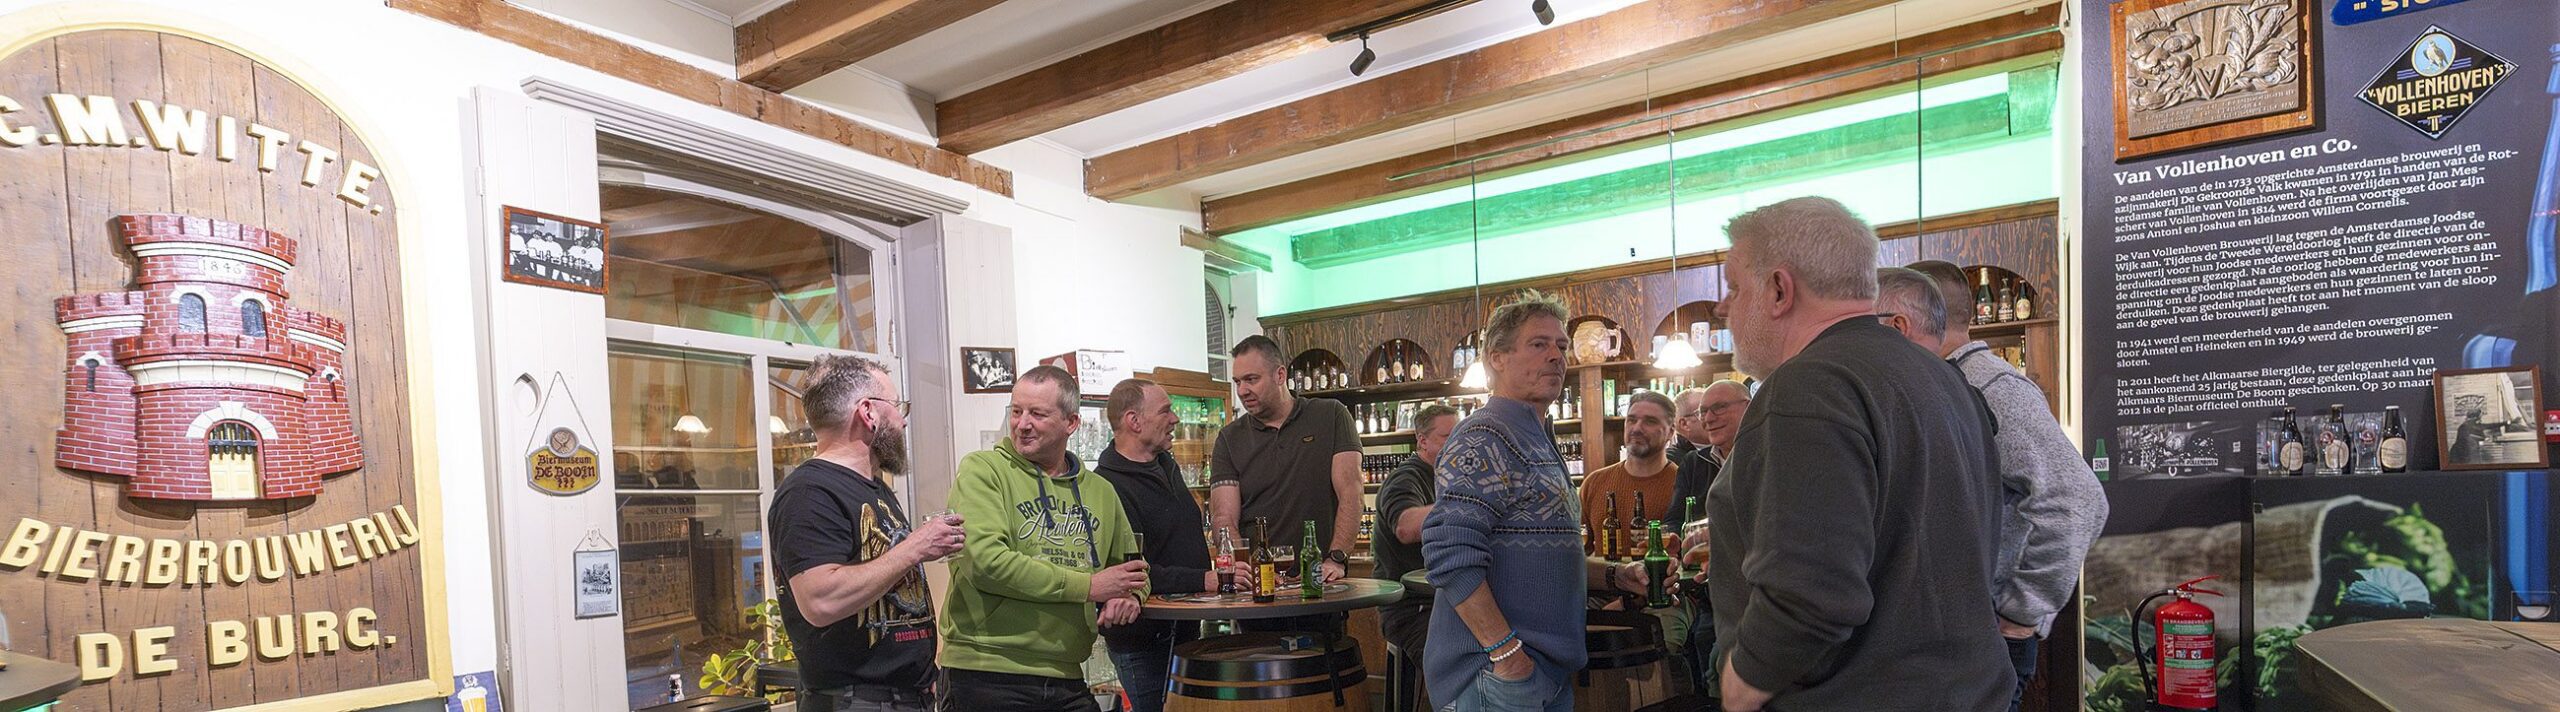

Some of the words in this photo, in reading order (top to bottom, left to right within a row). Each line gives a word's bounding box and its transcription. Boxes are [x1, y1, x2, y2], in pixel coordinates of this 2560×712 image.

[2397, 92, 2474, 117] BIEREN
[2112, 170, 2151, 186] Van
[2154, 149, 2286, 180] Vollenhoven
[2289, 144, 2318, 159] en
[2321, 137, 2357, 155] Co.
[2114, 194, 2128, 204] De
[2129, 188, 2176, 201] aandelen
[2177, 185, 2197, 195] van
[2199, 182, 2212, 191] de
[2214, 180, 2225, 189] in
[2227, 177, 2252, 189] 1733
[2253, 167, 2314, 185] opgerichte
[2315, 156, 2398, 175] Amsterdamse
[2400, 144, 2462, 163] brouwerij
[2464, 144, 2481, 153] en
[2114, 196, 2178, 213] azijnmakerij
[2180, 194, 2194, 204] De
[2196, 186, 2255, 202] Gekroonde
[2256, 181, 2282, 193] Valk
[2284, 176, 2333, 190] kwamen
[2335, 172, 2348, 182] in
[2350, 170, 2376, 182] 1791
[2378, 166, 2391, 176] in
[2393, 160, 2440, 174] handen
[2442, 157, 2466, 168] van
[2468, 153, 2485, 164] de
[2487, 148, 2518, 161] Rot-
[2114, 210, 2162, 223] terdamse
[2164, 203, 2201, 216] familie
[2202, 202, 2222, 211] van
[2224, 192, 2296, 208] Vollenhoven.
[2299, 188, 2315, 198] Na
[2317, 184, 2337, 195] het
[2338, 177, 2400, 192] overlijden
[2401, 174, 2425, 184] van
[2426, 170, 2448, 182] Jan
[2450, 166, 2485, 177] Mes-
[2114, 221, 2146, 233] schert
[2148, 220, 2167, 228] van
[2168, 210, 2235, 225] Vollenhoven
[2237, 207, 2248, 216] in
[2250, 205, 2275, 214] 1814
[2276, 199, 2306, 211] werd
[2308, 198, 2322, 207] de
[2324, 194, 2357, 205] firma
[2359, 183, 2425, 200] voortgezet
[2427, 181, 2458, 191] door
[2459, 176, 2484, 187] zijn
[2114, 233, 2144, 242] zoons
[2146, 226, 2182, 238] Antoni
[2199, 220, 2235, 233] Joshua
[2253, 211, 2309, 224] kleinzoon
[2310, 205, 2353, 217] Willem
[2355, 197, 2409, 211] Cornelis.
[2115, 253, 2128, 261] De
[2130, 251, 2150, 260] Van
[2151, 243, 2217, 257] Vollenhoven
[2219, 234, 2272, 249] Brouwerij
[2275, 233, 2293, 243] lag
[2295, 229, 2327, 240] tegen
[2329, 226, 2344, 235] de
[2346, 217, 2430, 233] Amsterdamse
[2432, 210, 2475, 225] Joodse
[2114, 260, 2138, 272] Wijk
[2140, 260, 2161, 268] aan.
[2163, 255, 2202, 266] Tijdens
[2204, 251, 2217, 261] de
[2218, 246, 2261, 259] Tweede
[2262, 237, 2341, 254] Wereldoorlog
[2342, 232, 2374, 244] heeft
[2376, 230, 2391, 240] de
[2393, 224, 2440, 238] directie
[2442, 223, 2466, 233] van
[2468, 219, 2485, 229] de
[2116, 350, 2140, 358] door
[2141, 345, 2177, 356] Amstel
[2195, 340, 2245, 351] Heineken
[2264, 337, 2275, 345] in
[2278, 336, 2305, 346] 1949
[2307, 331, 2336, 342] werd
[2338, 330, 2353, 339] de
[2355, 324, 2413, 338] brouwerij
[2416, 325, 2438, 334] ge-
[2130, 340, 2151, 348] 1941
[2153, 336, 2179, 345] werd
[2181, 335, 2200, 343] een
[2202, 327, 2271, 341] meerderheid
[2296, 324, 2310, 332] de
[2312, 320, 2365, 331] aandelen
[2368, 312, 2452, 326] overgenomen
[2116, 359, 2150, 367] sloten.
[2117, 379, 2127, 387] In
[2154, 375, 2180, 384] heeft
[2182, 373, 2199, 382] het
[2201, 370, 2258, 381] Alkmaarse
[2261, 365, 2315, 376] Biergilde,
[2318, 364, 2334, 372] ter
[2336, 357, 2408, 372] gelegenheid
[2411, 357, 2434, 365] van
[2117, 388, 2133, 397] het
[2135, 383, 2195, 395] aankomend
[2198, 384, 2210, 392] 25
[2213, 380, 2238, 392] jarig
[2239, 378, 2286, 388] bestaan,
[2288, 376, 2315, 384] deze
[2317, 369, 2389, 384] gedenkplaat
[2392, 369, 2414, 377] aan
[2116, 397, 2164, 406] Alkmaars
[2167, 392, 2233, 403] Biermuseum
[2236, 390, 2251, 398] De
[2253, 388, 2285, 397] Boom
[2288, 383, 2359, 396] geschonken.
[2361, 381, 2378, 391] Op
[2381, 381, 2396, 390] 30
[2142, 406, 2151, 414] is
[2153, 405, 2165, 413] de
[2168, 403, 2193, 414] plaat
[2196, 400, 2238, 410] officieel
[2241, 397, 2287, 407] onthuld.
[535, 465, 553, 480] DE
[554, 465, 595, 480] BOOM
[537, 454, 592, 466] Biermuseum
[0, 504, 420, 585] BIERBROUWERIJ
[77, 625, 178, 683] DE
[206, 607, 397, 666] BURG.
